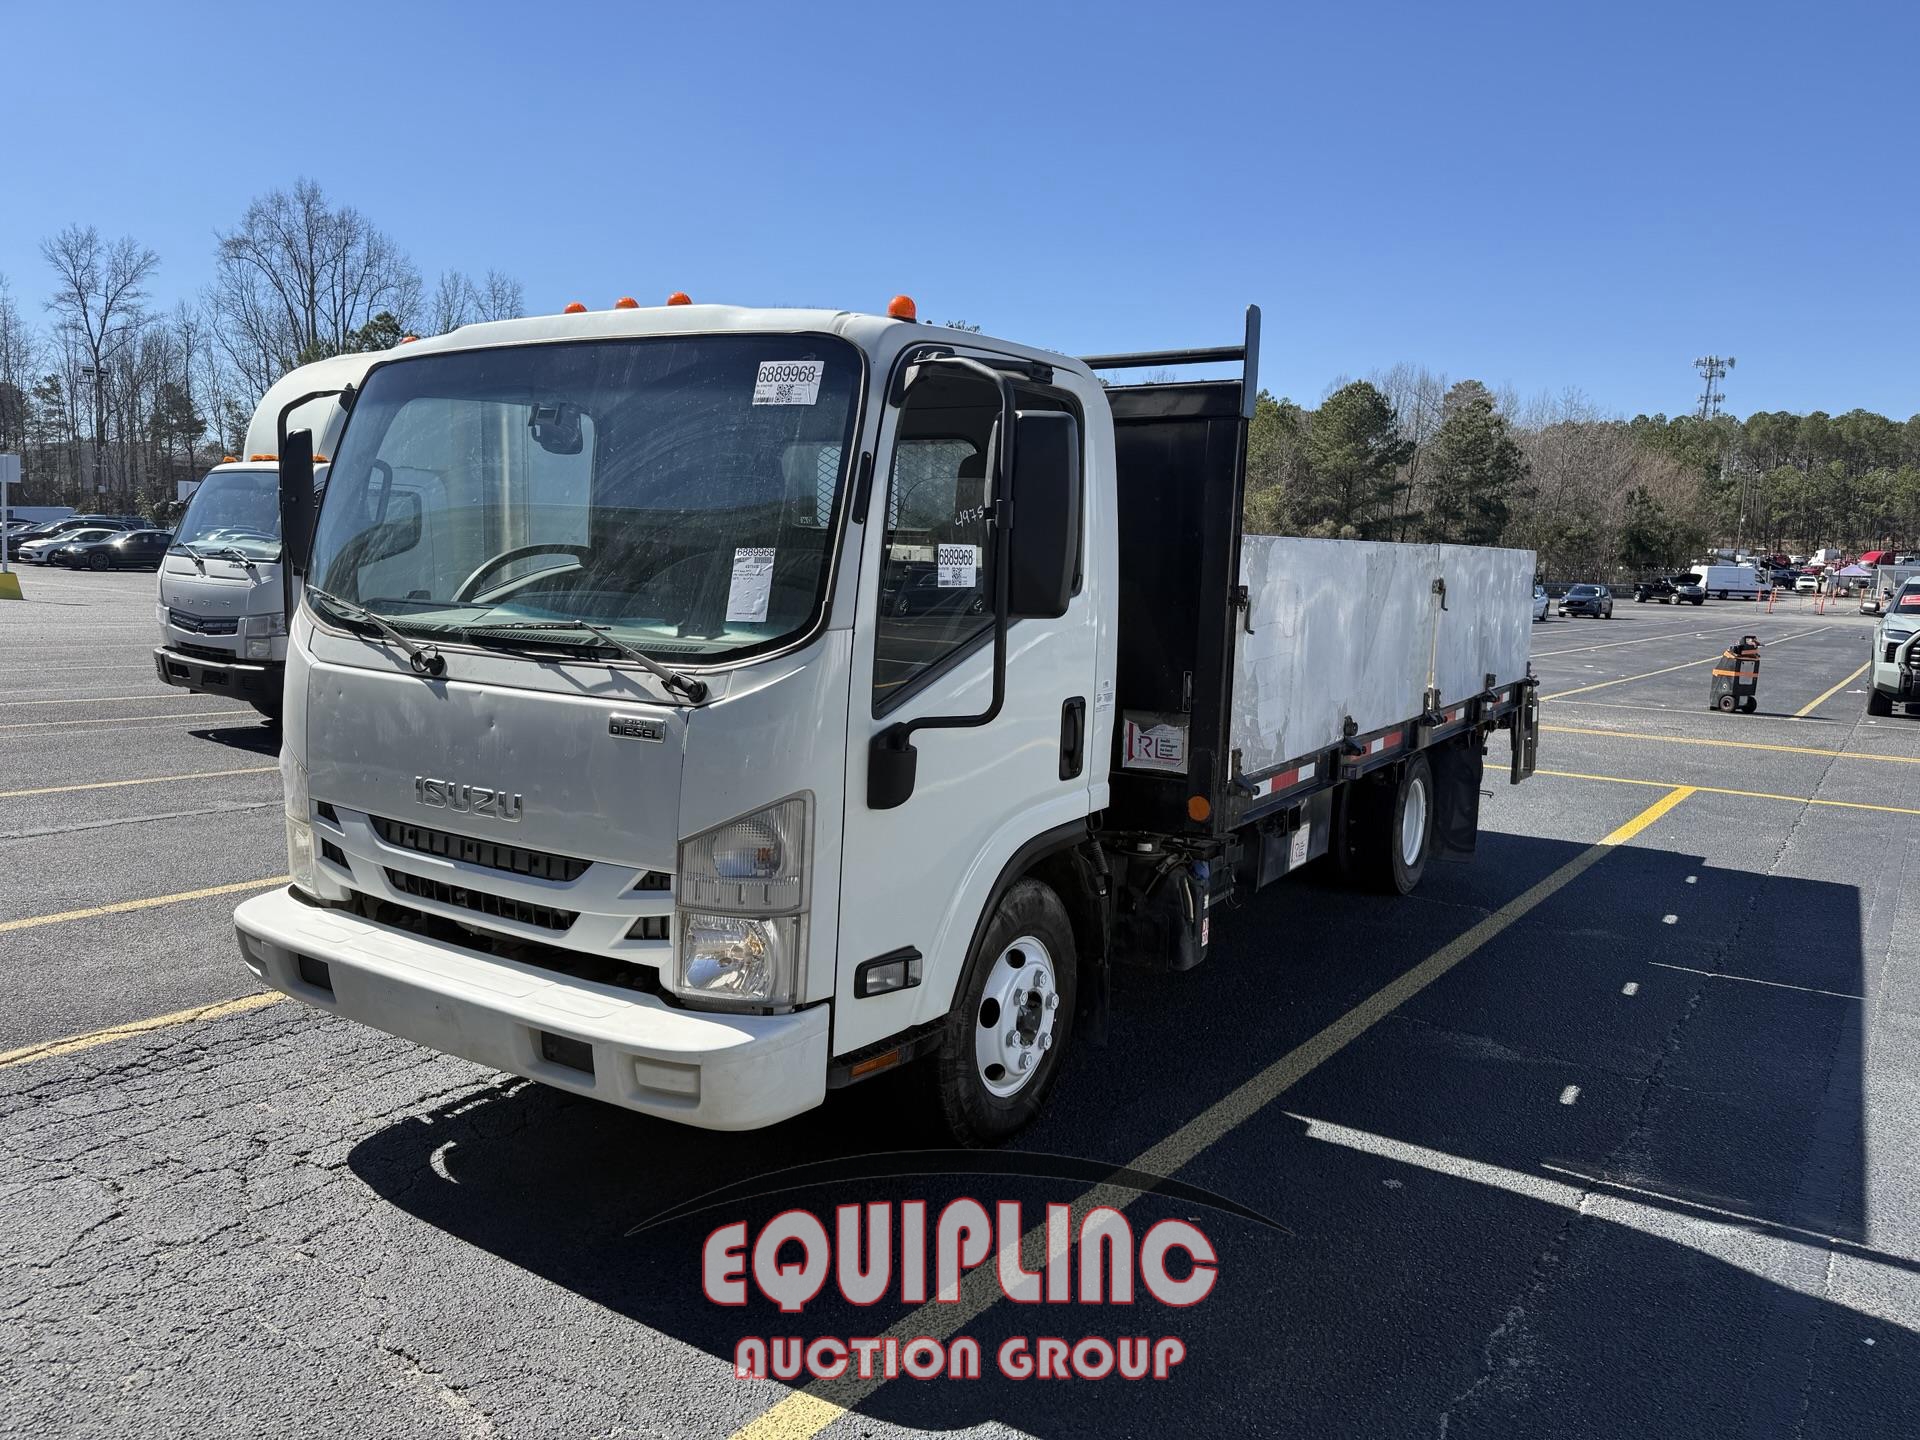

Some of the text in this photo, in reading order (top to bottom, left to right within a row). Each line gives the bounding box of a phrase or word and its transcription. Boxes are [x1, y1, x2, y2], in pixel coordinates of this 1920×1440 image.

[759, 365, 816, 383] 6889968
[737, 547, 775, 557] 6889968
[939, 548, 974, 566] 6889968
[610, 725, 661, 740] DIESEL
[415, 776, 522, 823] ISUZU
